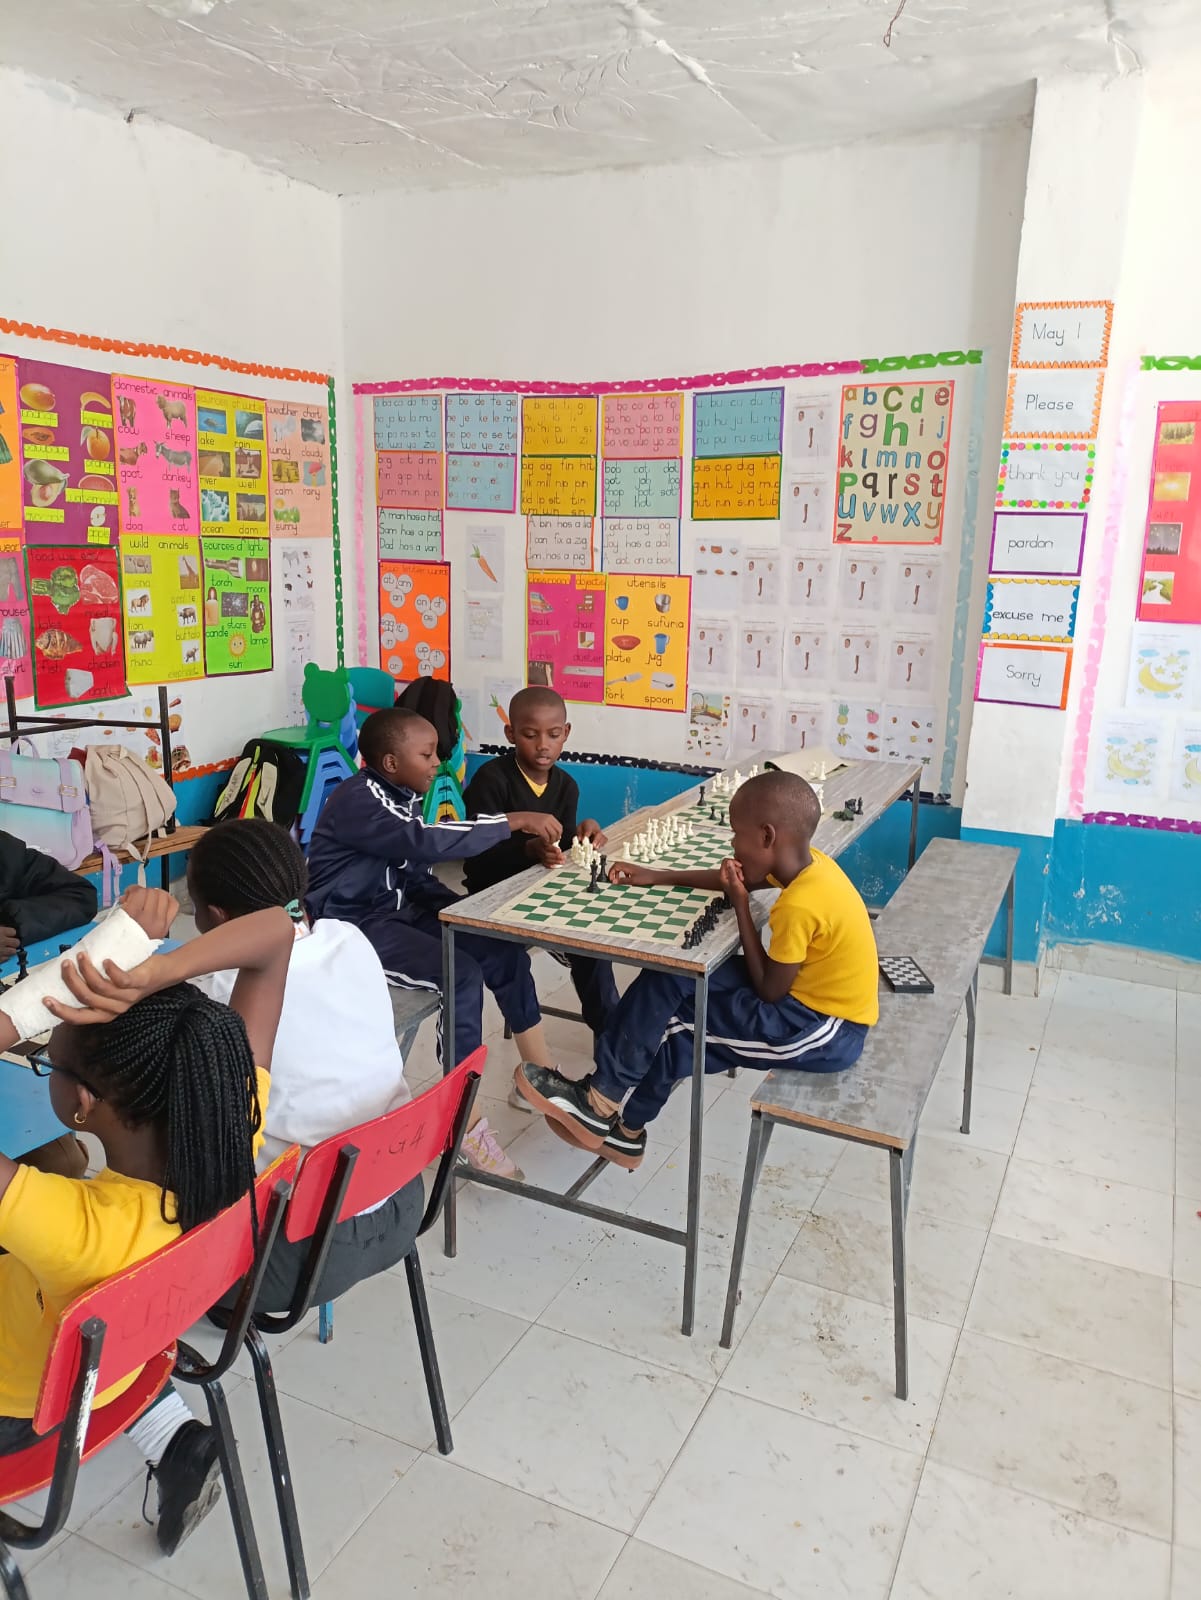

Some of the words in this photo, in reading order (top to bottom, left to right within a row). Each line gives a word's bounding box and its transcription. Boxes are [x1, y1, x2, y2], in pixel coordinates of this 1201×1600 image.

[1032, 322, 1066, 347] May
[113, 378, 158, 395] domestic
[163, 387, 193, 401] animals
[844, 387, 858, 402] a
[862, 386, 878, 406] b
[910, 387, 925, 414] d
[934, 386, 950, 407] e
[1025, 393, 1075, 412] Please
[268, 404, 299, 416] weather
[302, 406, 322, 419] chart
[696, 418, 710, 433] gu
[730, 415, 743, 431] ju
[750, 410, 759, 424] lu
[118, 425, 139, 435] cow
[491, 431, 503, 439] se
[842, 413, 854, 440] f
[859, 413, 879, 439] g
[882, 413, 910, 447] h
[918, 418, 925, 437] i
[936, 415, 946, 440] j
[165, 430, 190, 447] sheep
[696, 437, 709, 446] nu
[714, 435, 727, 449] pu
[734, 435, 746, 443] ru
[750, 434, 764, 442] su
[767, 428, 780, 441] tu
[270, 445, 291, 460] windy
[498, 442, 511, 451] ze
[301, 446, 323, 463] cloudy
[840, 445, 854, 469] k
[860, 447, 868, 470] l
[876, 449, 898, 468] m
[904, 450, 922, 470] n
[121, 465, 143, 483] goat
[162, 467, 192, 488] donkey
[1007, 462, 1047, 482] thank
[1055, 470, 1081, 488] you
[238, 481, 257, 489] well
[274, 487, 294, 496] calm
[736, 480, 755, 495] jug
[861, 471, 880, 499] q
[888, 472, 898, 500] r
[929, 472, 944, 498] t
[302, 488, 321, 501] rainy
[758, 493, 778, 507] tub
[406, 509, 420, 521] has
[427, 510, 442, 521] hat
[539, 514, 552, 528] bin
[557, 514, 573, 528] has
[924, 500, 942, 530] y
[172, 518, 189, 531] cat
[201, 525, 224, 534] ocean
[239, 523, 259, 534] dam
[275, 522, 298, 537] sunny
[380, 522, 397, 535] Sam
[400, 524, 415, 536] has
[426, 530, 442, 543] pan
[129, 535, 149, 548] wild
[158, 537, 188, 549] animals
[204, 542, 234, 551] sources
[380, 537, 394, 550] Dad
[399, 539, 414, 551] has
[534, 537, 548, 545] can
[625, 535, 641, 548] has
[1008, 534, 1054, 554] pardon
[211, 574, 232, 587] torch
[627, 575, 667, 588] utensils
[246, 585, 266, 593] moon
[227, 616, 246, 629] stars
[610, 617, 629, 631] cup
[647, 616, 684, 629] sufuria
[992, 610, 1034, 622] excuse
[1041, 611, 1065, 624] me
[206, 625, 229, 638] candle
[250, 635, 269, 650] lamp
[605, 649, 631, 665] plate
[645, 651, 662, 667] jug
[229, 661, 243, 669] sun
[1006, 664, 1042, 688] Sorry
[605, 687, 625, 700] fork
[644, 696, 674, 709] spoon
